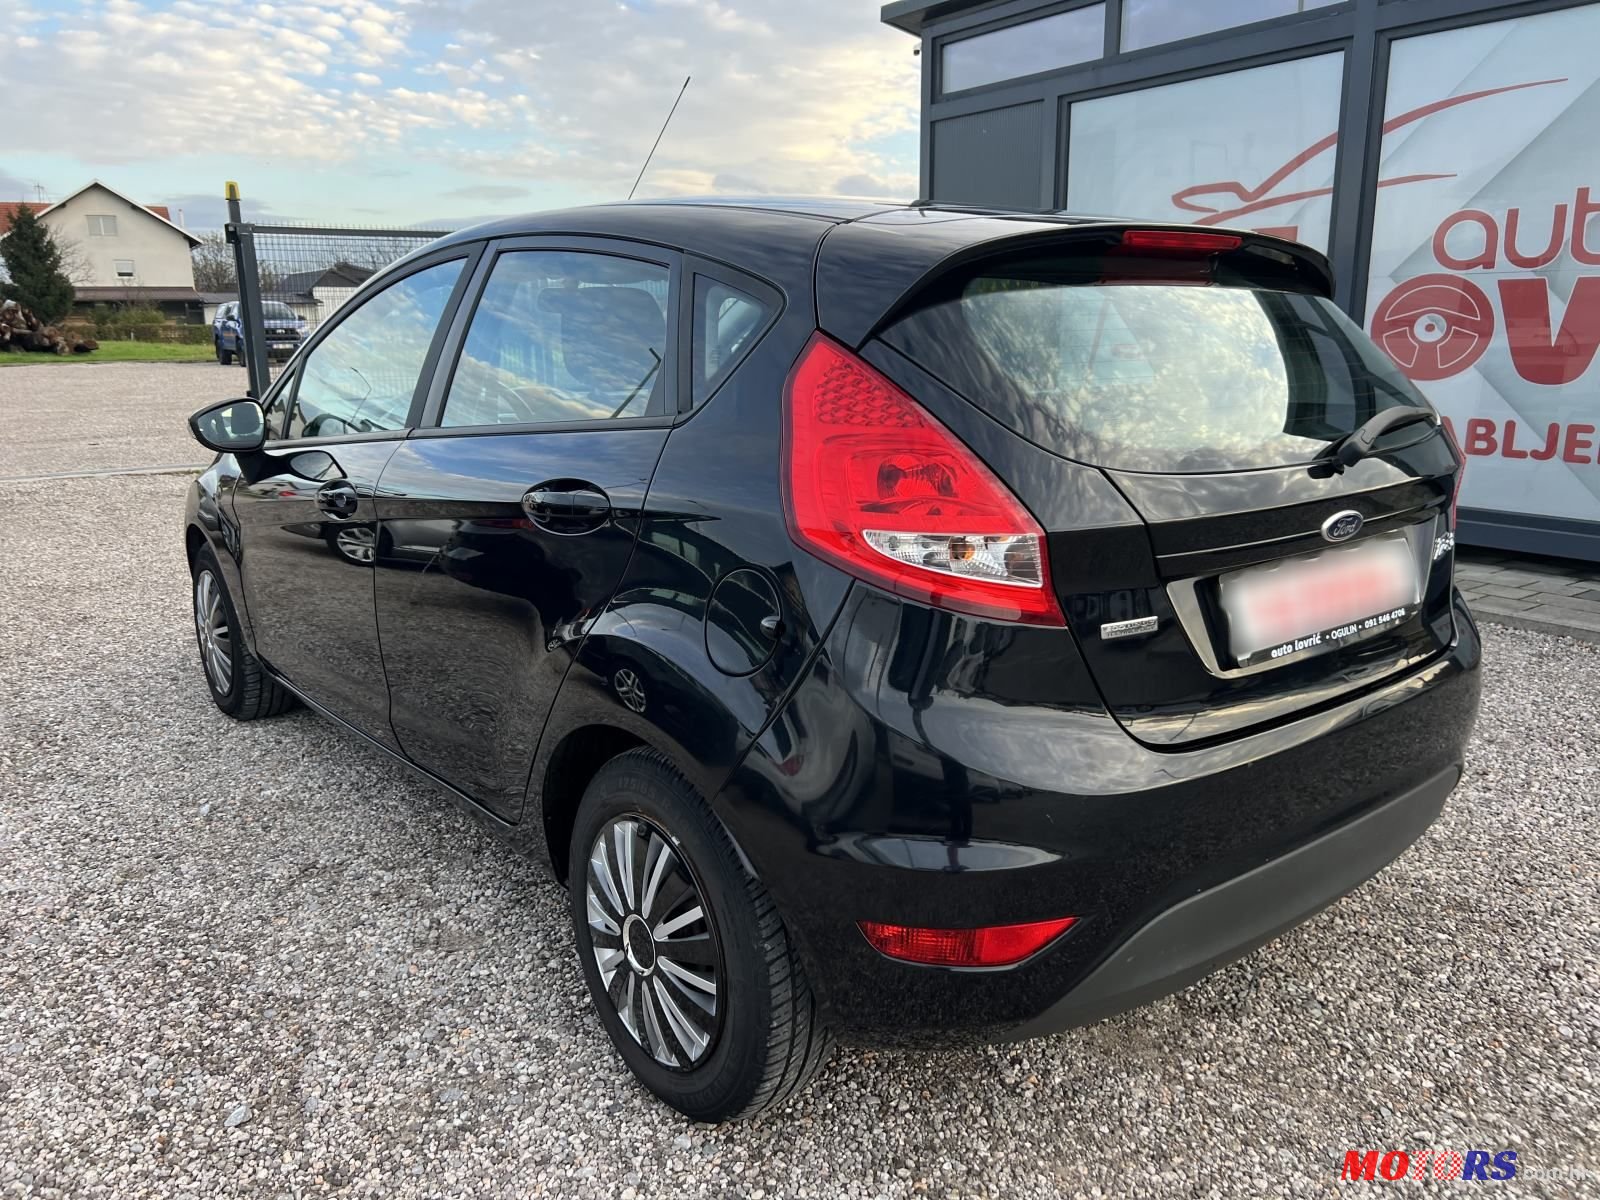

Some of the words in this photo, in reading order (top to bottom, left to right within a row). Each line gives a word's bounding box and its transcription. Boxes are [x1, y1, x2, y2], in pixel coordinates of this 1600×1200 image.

[1441, 416, 1600, 465] BLJE
[1333, 517, 1358, 537] Ford
[1270, 644, 1293, 659] auto
[1294, 632, 1322, 652] lovrić
[1330, 623, 1358, 640] OGULIN
[1364, 617, 1378, 629] 091
